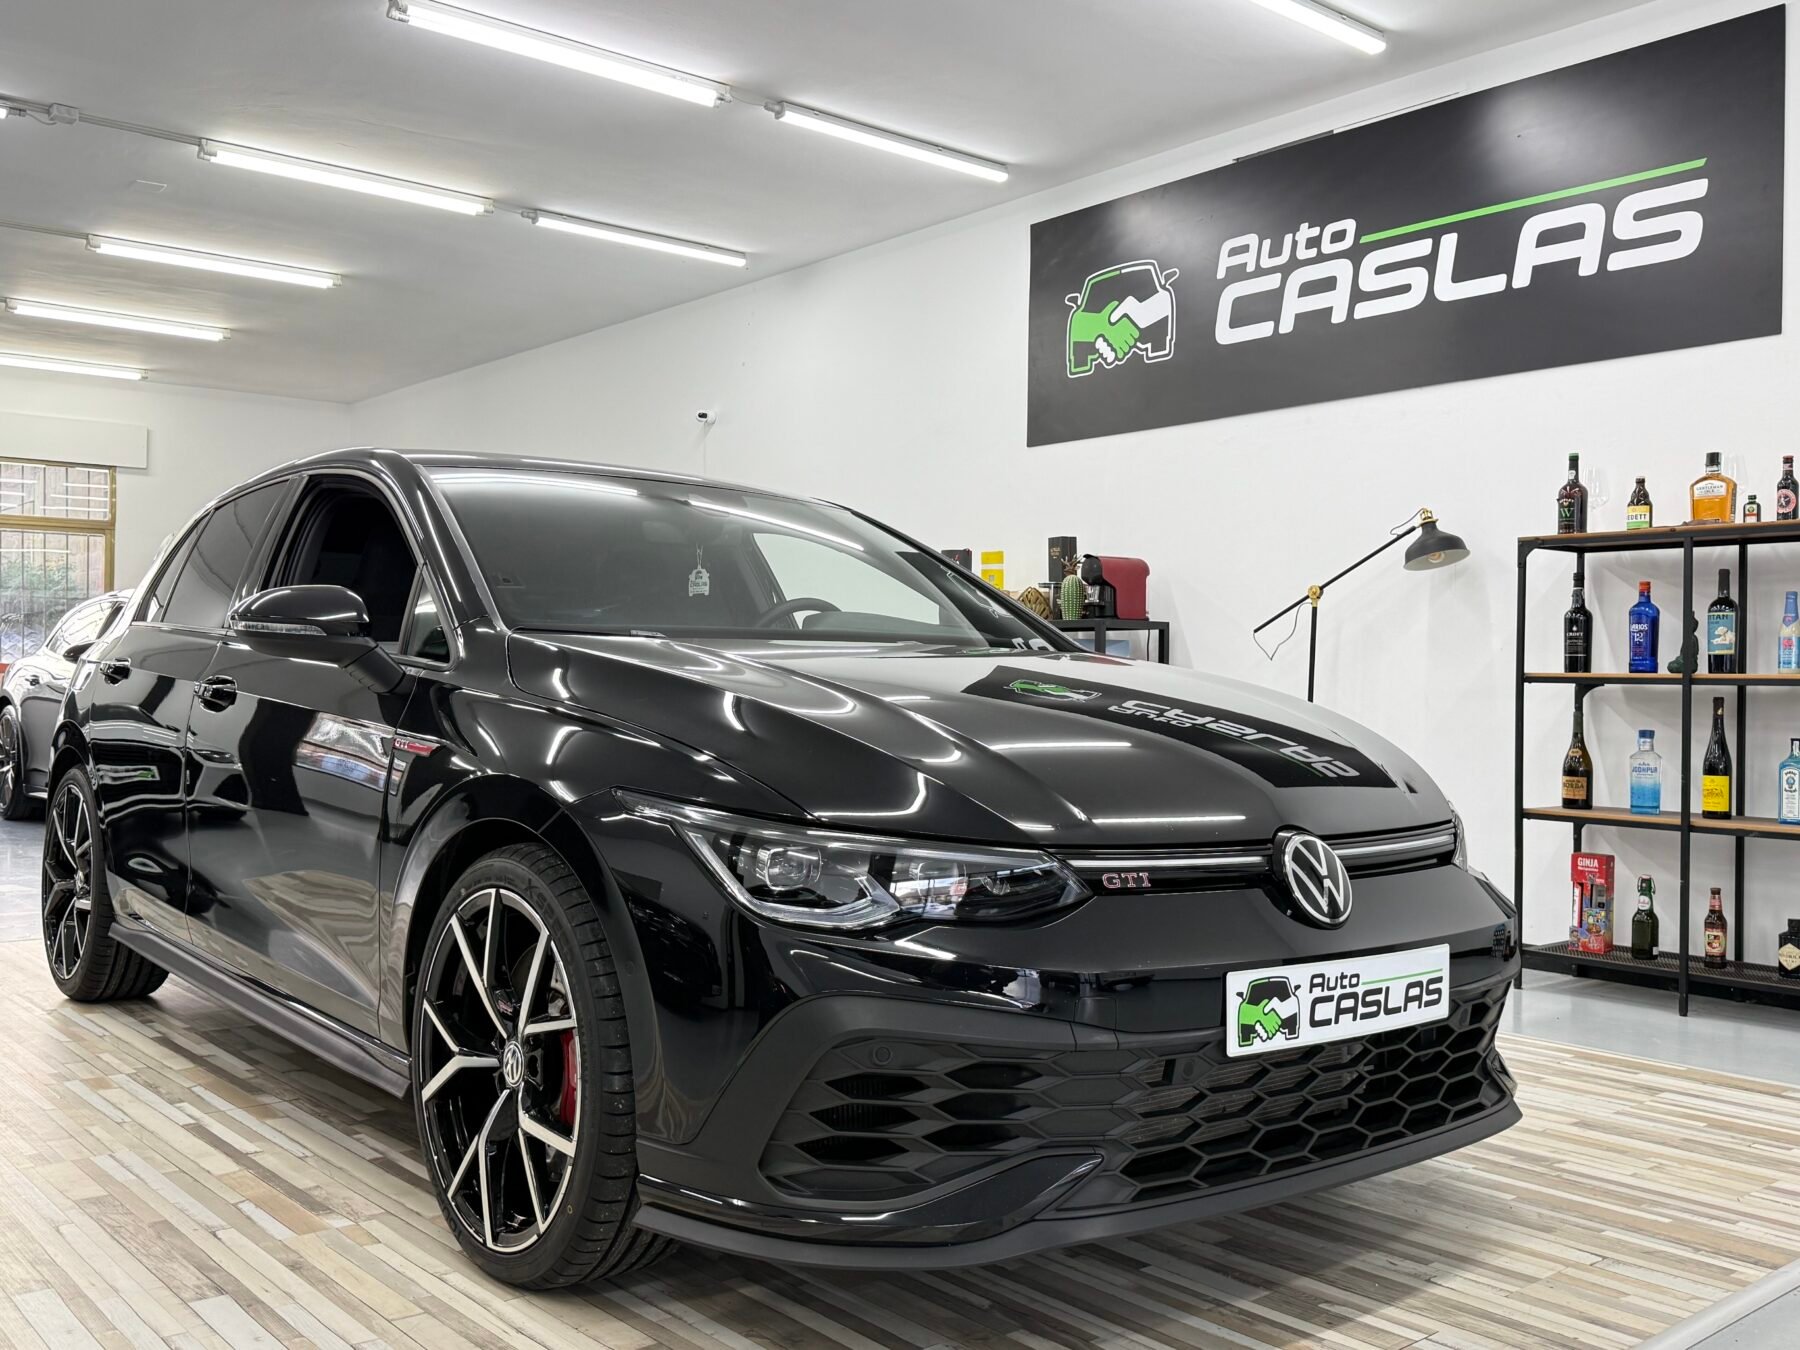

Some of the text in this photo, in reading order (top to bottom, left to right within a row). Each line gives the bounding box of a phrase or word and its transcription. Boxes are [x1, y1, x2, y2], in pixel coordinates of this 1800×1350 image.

[1217, 218, 1357, 280] Auto
[1215, 178, 1708, 345] CASLAS
[394, 738, 409, 749] GTI
[1577, 856, 1599, 868] GINJA
[1102, 871, 1152, 889] GTI
[1309, 971, 1361, 994] Auto
[1309, 975, 1444, 1029] CASLAS
